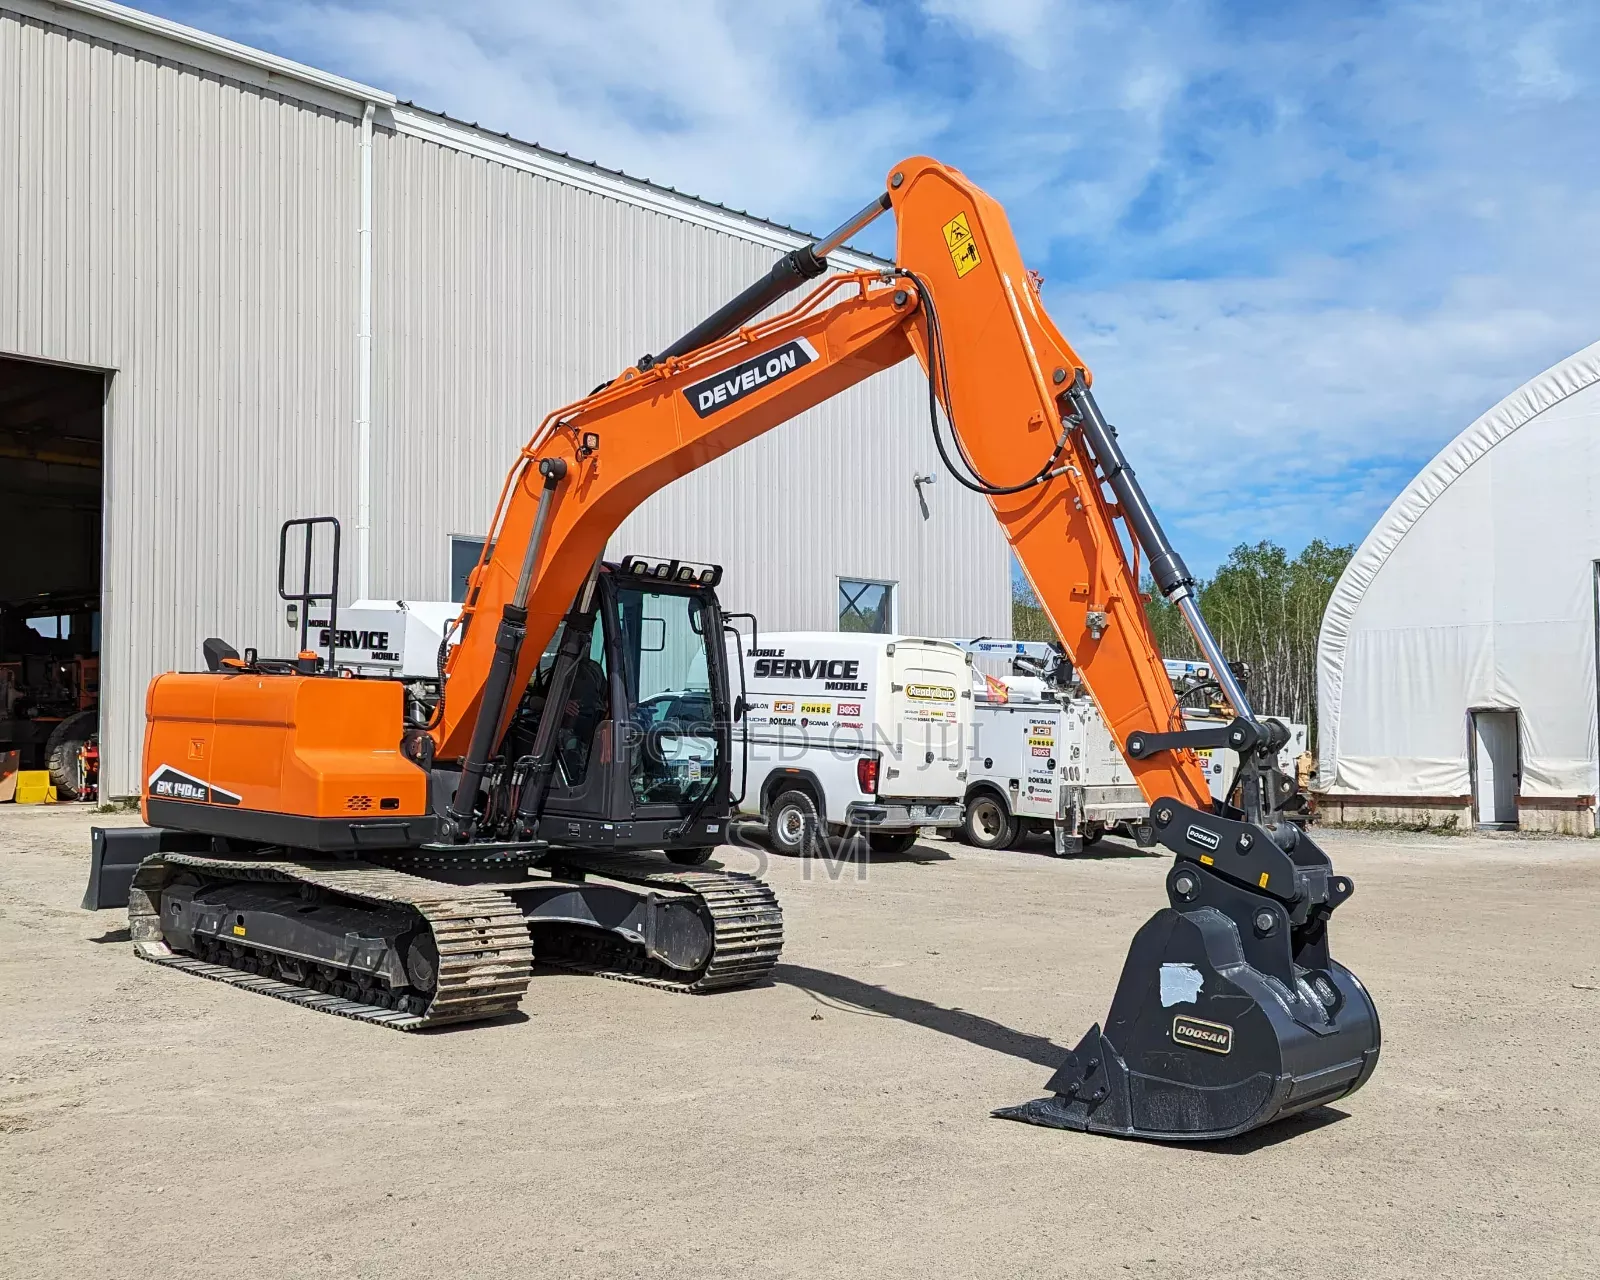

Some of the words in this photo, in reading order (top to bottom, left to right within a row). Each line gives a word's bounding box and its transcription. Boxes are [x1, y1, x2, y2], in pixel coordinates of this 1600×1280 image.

[699, 350, 796, 411] DEVELON
[319, 630, 389, 651] SERVICE
[371, 652, 400, 661] MOBILE
[747, 649, 785, 657] MOBILE
[754, 659, 859, 680] SERVICE
[825, 682, 868, 691] MOBILE
[910, 686, 954, 699] ReadyQuip
[775, 703, 794, 711] JCB
[801, 705, 831, 713] PONSSE
[838, 706, 860, 715] BOSS
[769, 718, 796, 726] ROKBAK
[1033, 749, 1050, 757] BOSS
[1028, 777, 1052, 785] ROKBAK
[1190, 830, 1216, 845] DOOSAN
[1177, 1025, 1227, 1044] DOOSAN
